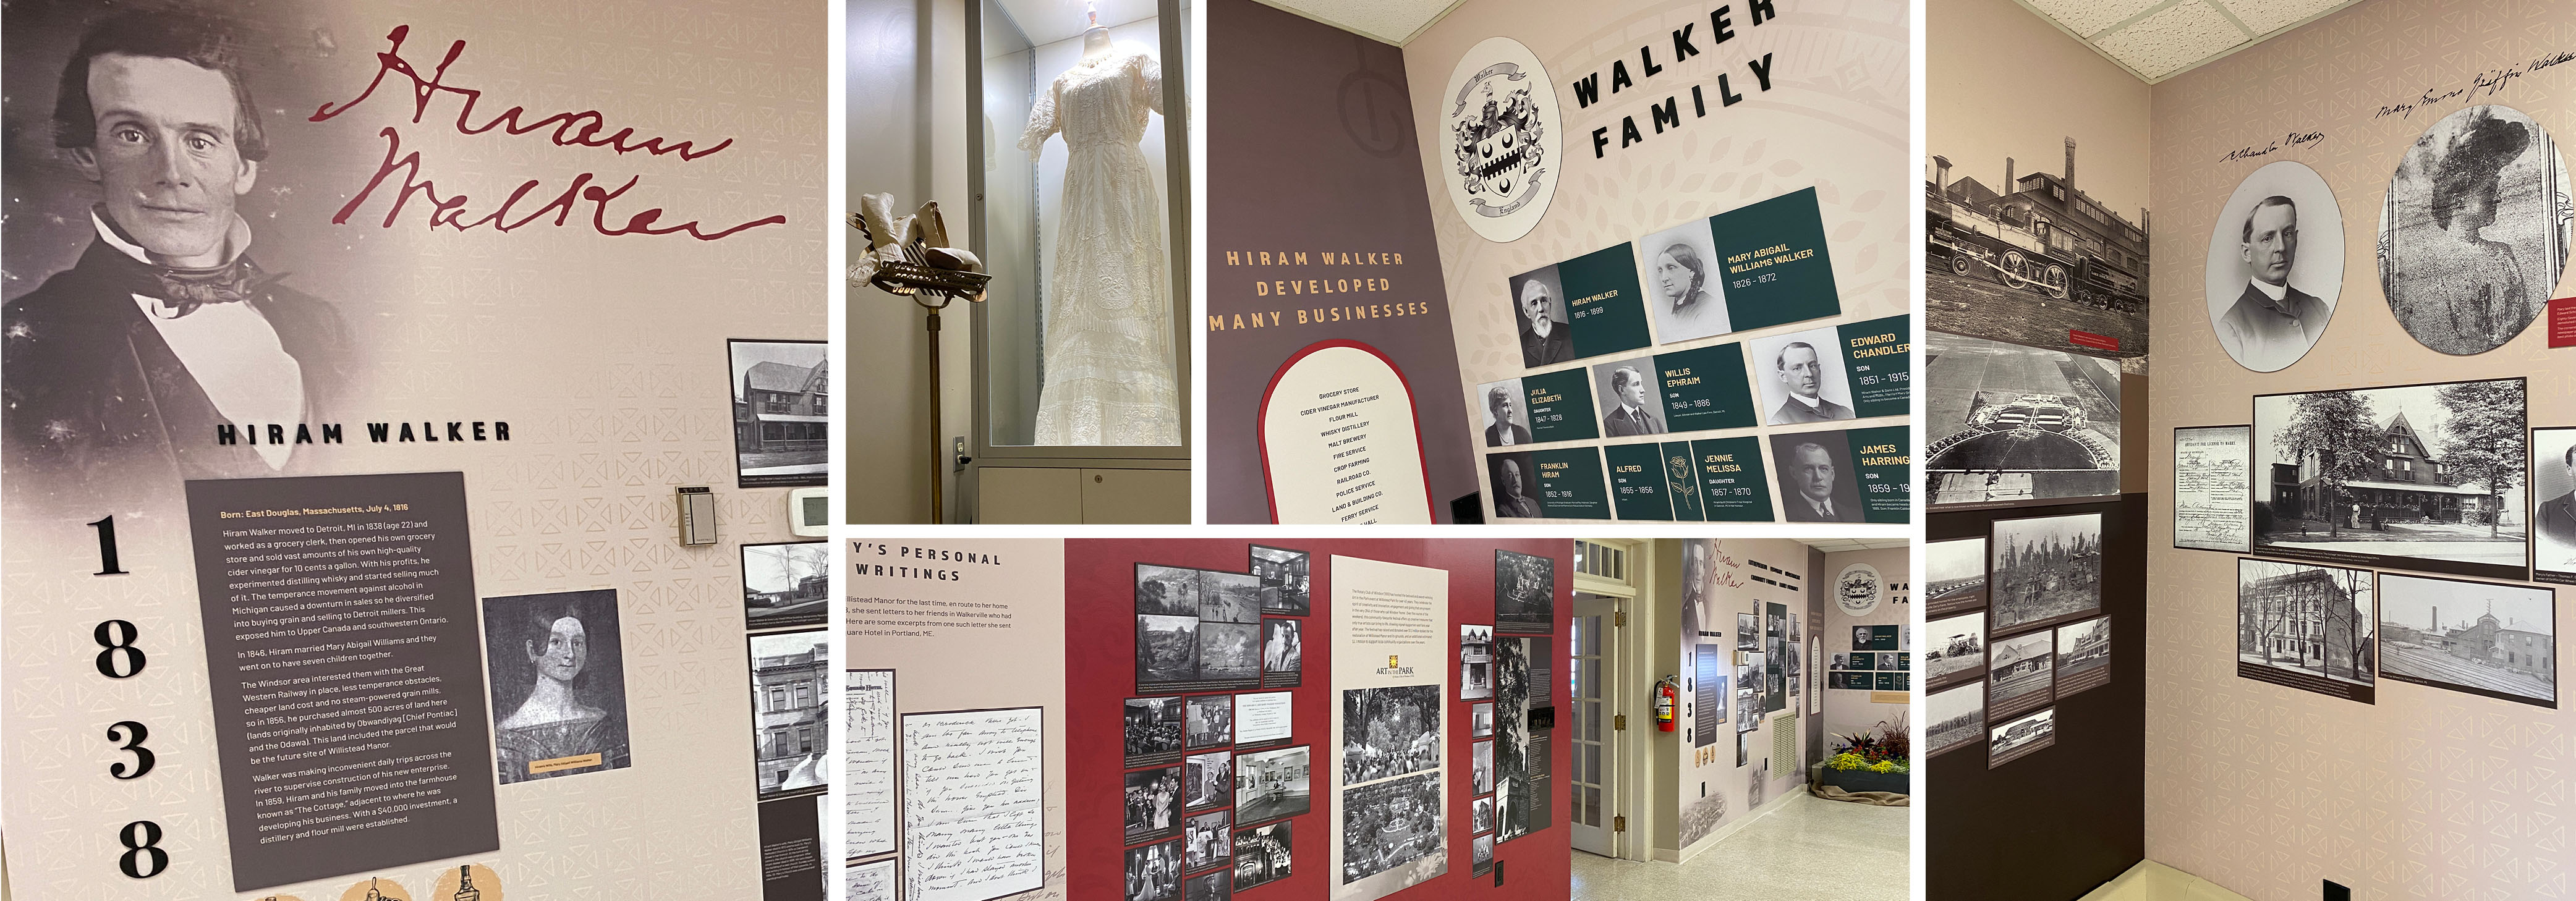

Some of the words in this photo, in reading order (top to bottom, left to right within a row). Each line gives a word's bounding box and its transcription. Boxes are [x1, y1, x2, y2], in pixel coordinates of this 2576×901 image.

[1573, 0, 1775, 109] WALKER
[1474, 69, 1493, 83] Walker
[1592, 53, 1772, 158] FAMILY
[2285, 131, 2324, 150] Walker
[332, 127, 786, 240] Walker
[1498, 201, 1521, 214] England
[1226, 251, 1307, 265] HIRAM
[1321, 252, 1403, 265] WALKER
[1727, 252, 1751, 264] MARY
[1754, 243, 1790, 258] ABIGAIL
[1729, 258, 1773, 274] WILLIAMS
[1774, 248, 1814, 264] WALKER
[1256, 278, 1389, 296] DEVELOPED
[1732, 278, 1751, 289] 1826
[1758, 273, 1777, 283] 1872
[1571, 296, 1591, 307] HIRAM
[1591, 289, 1618, 302] WALKER
[1209, 311, 1281, 331] MANY
[1297, 302, 1427, 324] BUSINESSES
[1574, 310, 1586, 319] 1816
[1589, 307, 1604, 315] 1899
[1850, 333, 1895, 347] EDWARD
[1853, 342, 1910, 358] CHANDLER
[1664, 368, 1691, 378] WILLIS
[1859, 375, 1879, 385] 1851
[1887, 370, 1909, 382] 1915
[1667, 376, 1701, 387] EPHRAIM
[1319, 390, 1342, 399] GROCERY
[1530, 388, 1546, 396] JULIA
[1531, 394, 1562, 404] ELIZABETH
[1300, 408, 1317, 416] CIDER
[1317, 403, 1340, 412] VINEGAR
[1340, 395, 1379, 407] MANUFACTURER
[1671, 401, 1688, 409] 1849
[1693, 399, 1711, 407] 1886
[1328, 414, 1346, 422] FLOUR
[1550, 413, 1562, 421] 1928
[218, 424, 344, 445] HIRAM
[367, 422, 511, 443] WALKER
[1320, 428, 1340, 437] WHISKY
[1341, 420, 1369, 432] DISTILLERY
[1328, 440, 1342, 448] MALT
[1343, 433, 1366, 444] BREWERY
[1333, 452, 1345, 460] FIRE
[1345, 446, 1366, 456] SERVICE
[1860, 444, 1896, 454] JAMES
[1333, 464, 1347, 472] CROP
[1348, 457, 1369, 468] FARMING
[1704, 454, 1733, 462] JENNIE
[1862, 455, 1910, 466] HARRING
[1617, 465, 1641, 473] ALFRED
[1706, 464, 1741, 473] MELISSA
[1337, 472, 1362, 484] RAILROAD
[1336, 487, 1354, 497] POLICE
[1354, 480, 1375, 491] SERVICE
[1733, 488, 1751, 496] 1870
[1868, 484, 1890, 493] 1859
[1332, 503, 1346, 512] LAND
[1352, 493, 1374, 505] BUILDING
[266, 509, 301, 517] Douglas,
[302, 506, 364, 515] Massachusetts,
[365, 505, 382, 513] July
[1341, 512, 1358, 522] FERRY
[1358, 504, 1379, 516] SERVICE
[278, 527, 305, 535] moved
[316, 524, 345, 533] Detroit,
[383, 522, 399, 530] (age
[401, 520, 413, 528] 22)
[224, 542, 254, 550] worked
[273, 541, 304, 549] grocery
[347, 535, 376, 545] opened
[407, 534, 435, 542] grocery
[846, 541, 887, 556] Y'S
[901, 546, 1000, 565] PERSONAL
[856, 563, 959, 581] WRITINGS
[1710, 561, 1743, 588] Walker
